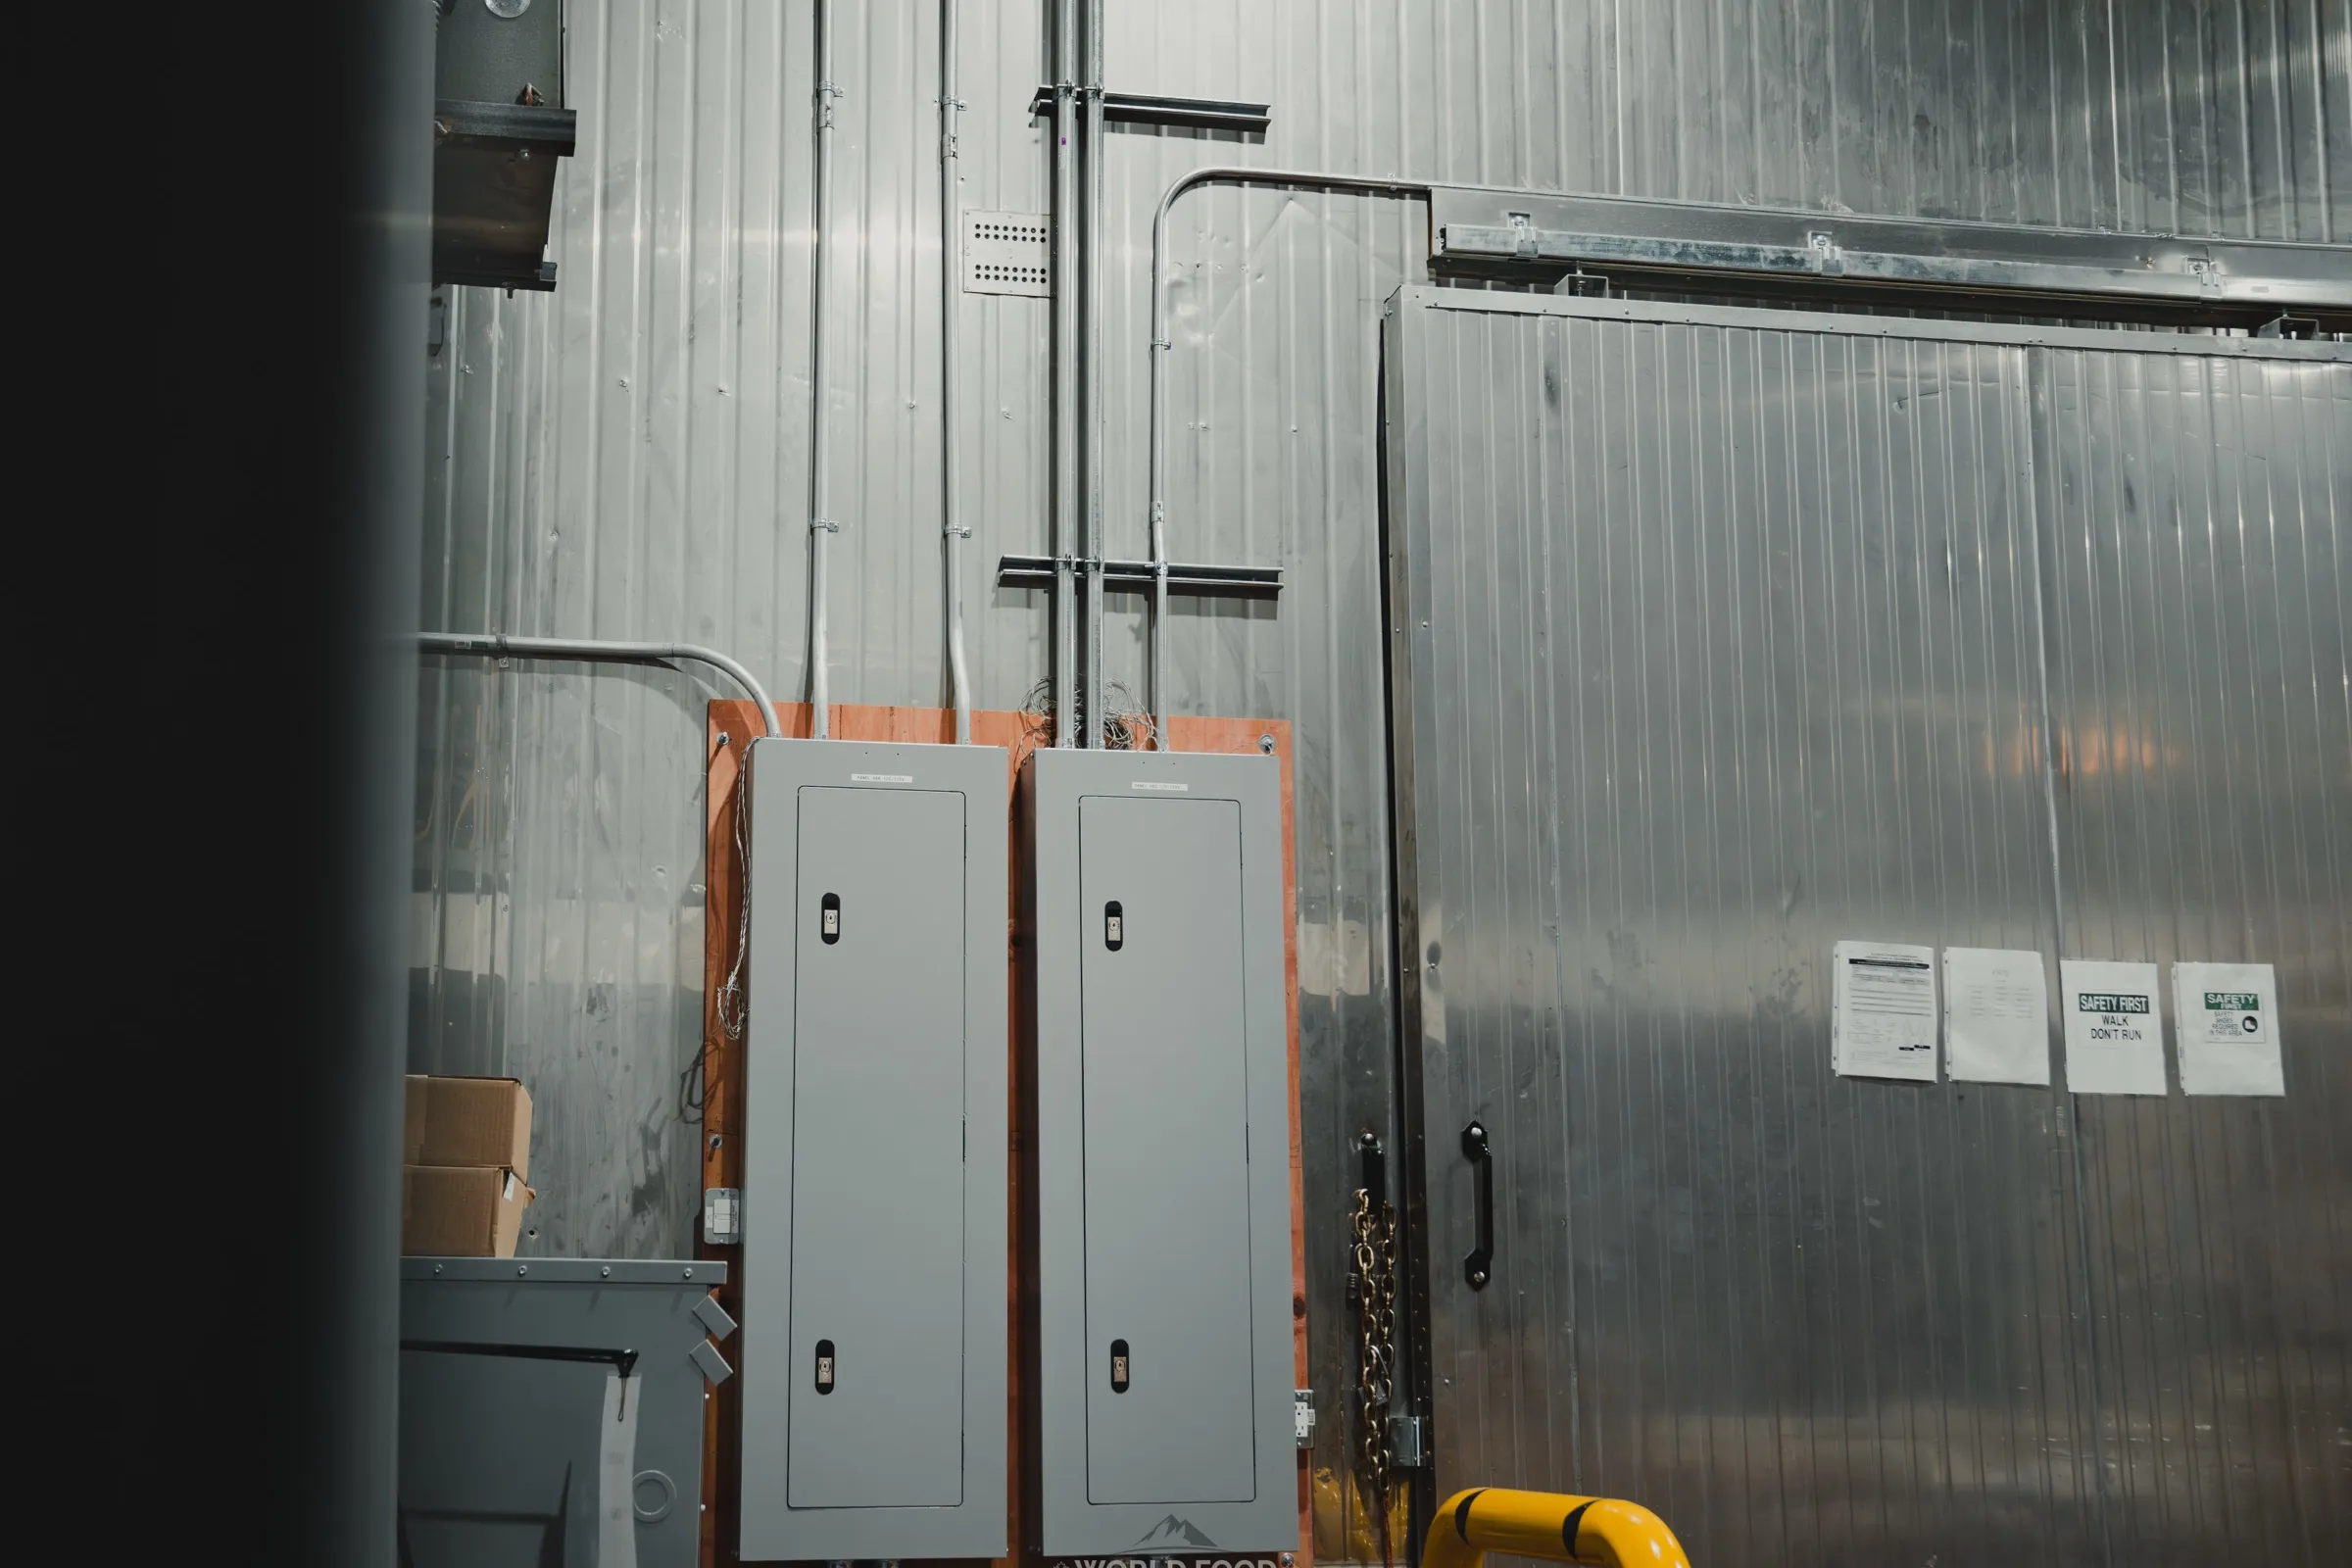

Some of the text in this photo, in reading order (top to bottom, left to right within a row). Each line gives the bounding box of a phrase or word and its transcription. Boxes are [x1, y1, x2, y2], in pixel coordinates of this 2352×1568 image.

[2081, 995, 2146, 1011] SAFETY FIRST
[2207, 994, 2254, 1004] SAFETY
[2101, 1014, 2129, 1026] WALK
[2090, 1028, 2142, 1041] DON'T RUN
